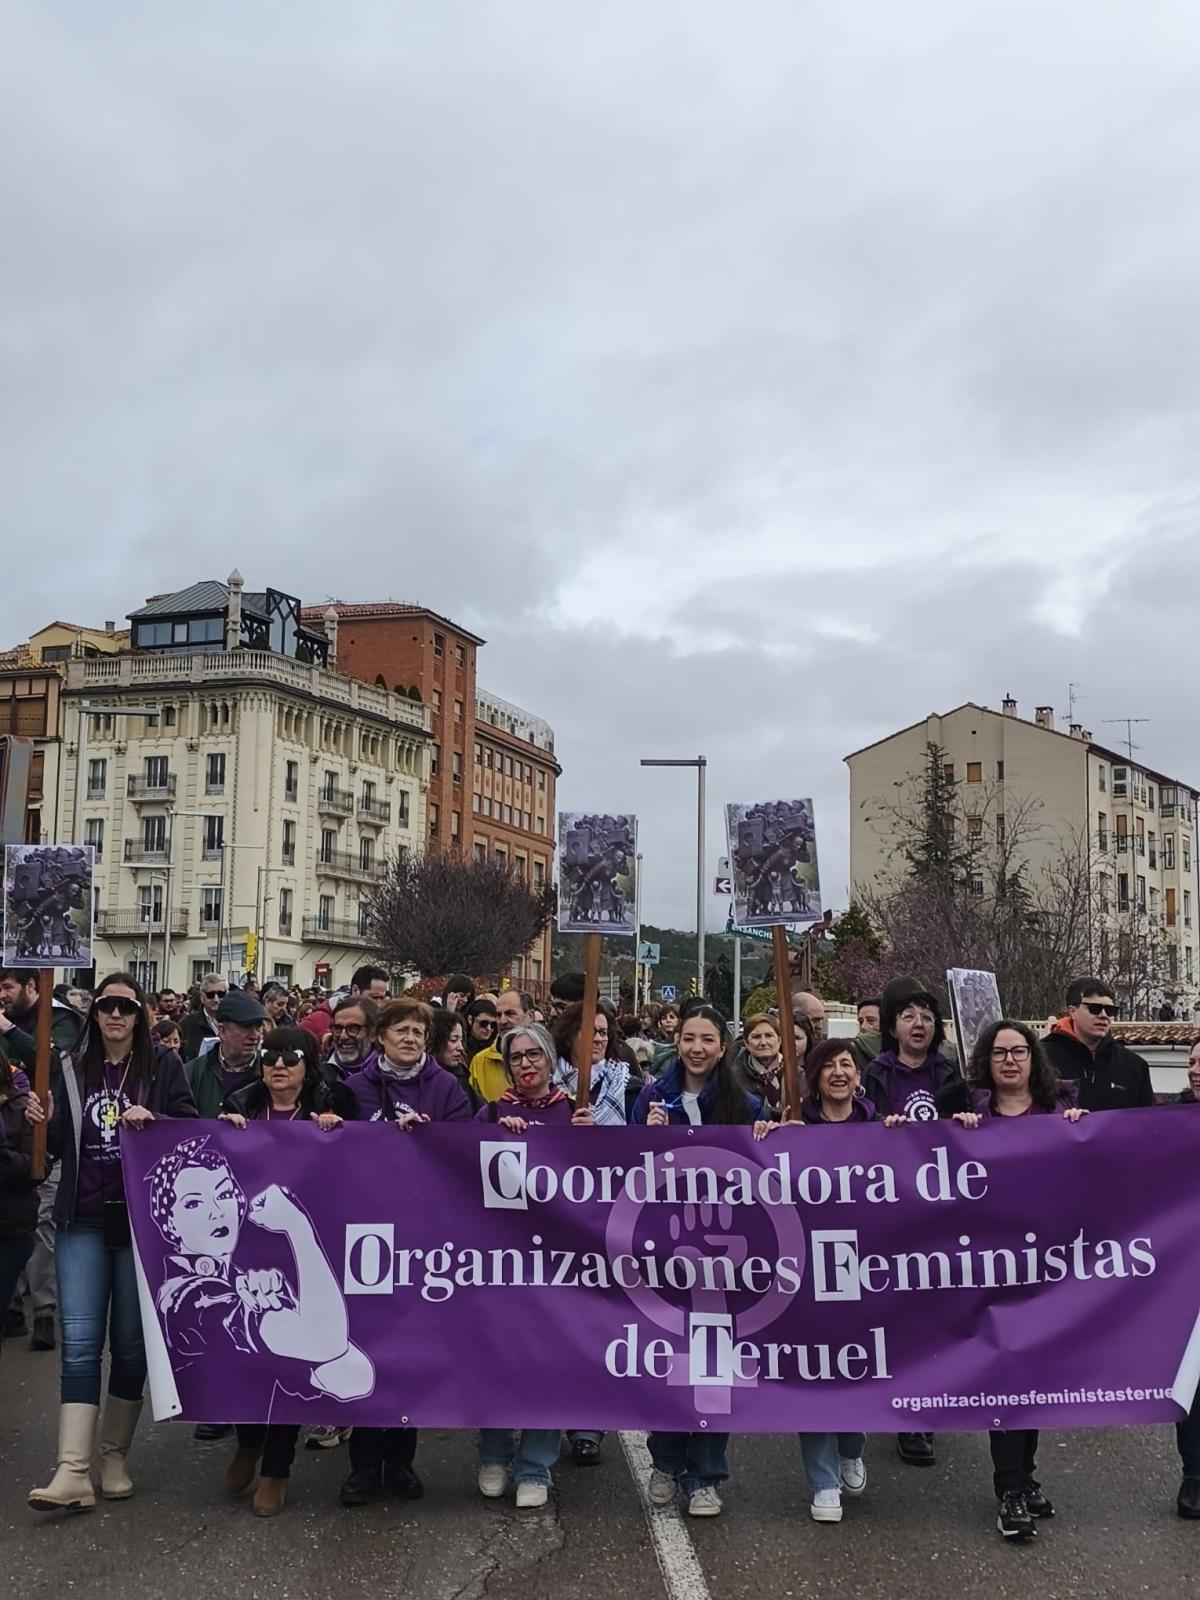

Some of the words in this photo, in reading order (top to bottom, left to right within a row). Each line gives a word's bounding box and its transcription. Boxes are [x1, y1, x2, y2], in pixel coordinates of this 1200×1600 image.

[480, 1141, 899, 1210] Coordinadora
[916, 1146, 988, 1201] de
[344, 1223, 801, 1303] Organizaciones
[811, 1228, 1156, 1301] Feministas
[605, 1323, 674, 1378] de
[689, 1313, 893, 1386] Teruel
